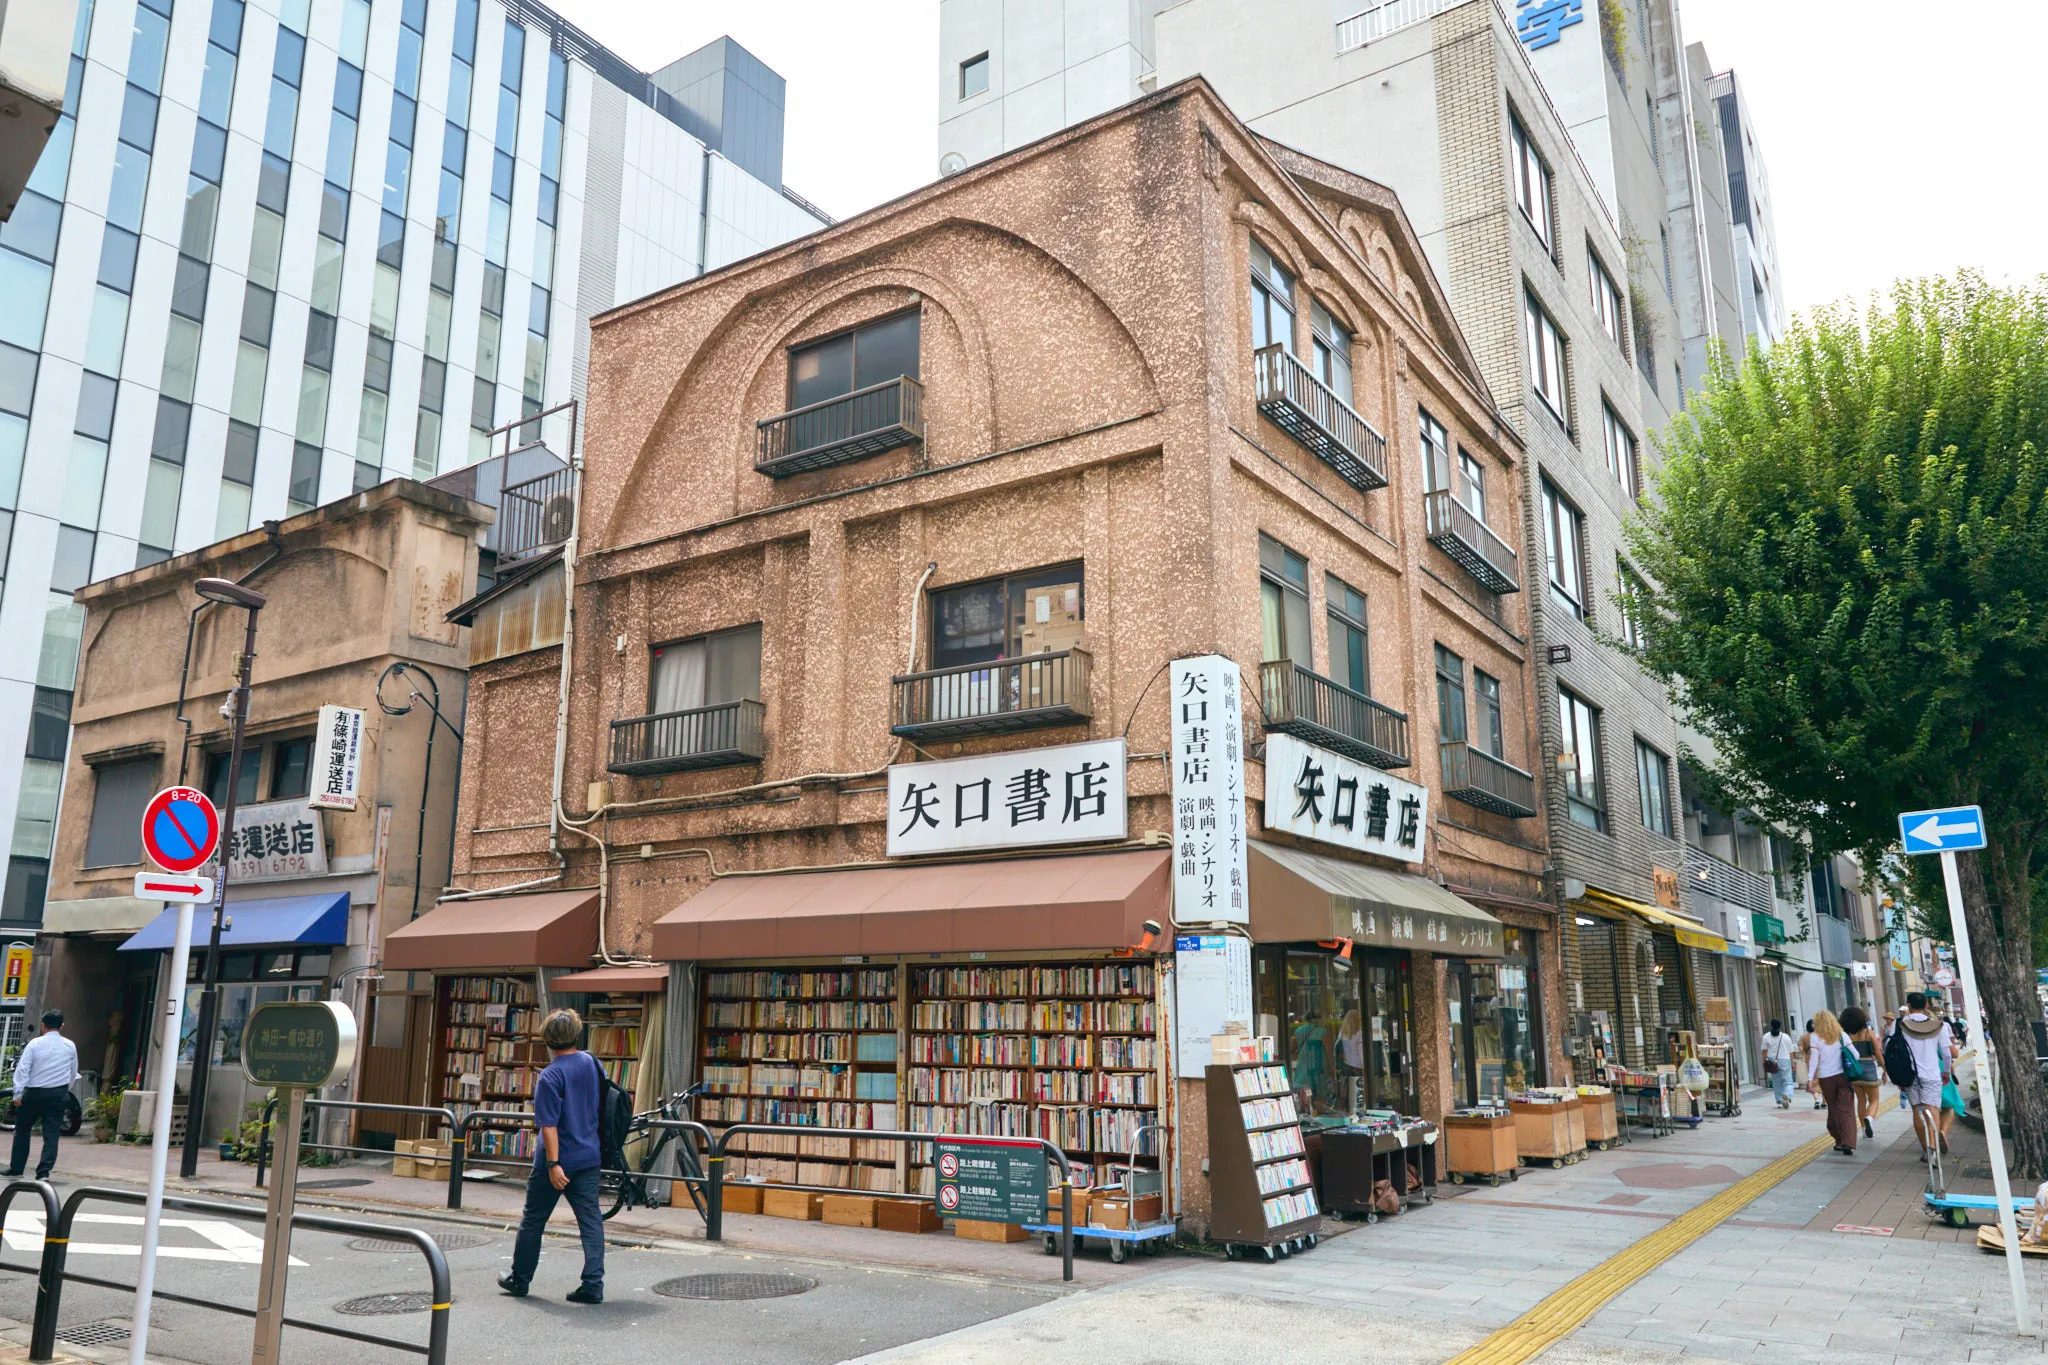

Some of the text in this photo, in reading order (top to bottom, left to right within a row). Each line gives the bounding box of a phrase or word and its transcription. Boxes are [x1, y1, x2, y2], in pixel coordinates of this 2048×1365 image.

[1180, 672, 1210, 784] 矢口書店
[171, 790, 202, 804] 8-20
[898, 762, 1110, 837] 矢口書店
[1223, 673, 1242, 909] 映画・演劇・シナリオ・戯曲
[1292, 755, 1421, 849] 矢口書店
[1179, 797, 1196, 876] 演劇・戯曲
[1199, 796, 1218, 908] 映画・シナリオ
[1352, 909, 1376, 935] 映画
[1392, 915, 1413, 940] 演劇
[1460, 925, 1493, 948] シナリオ
[959, 1158, 998, 1170] 路上喫煙禁止
